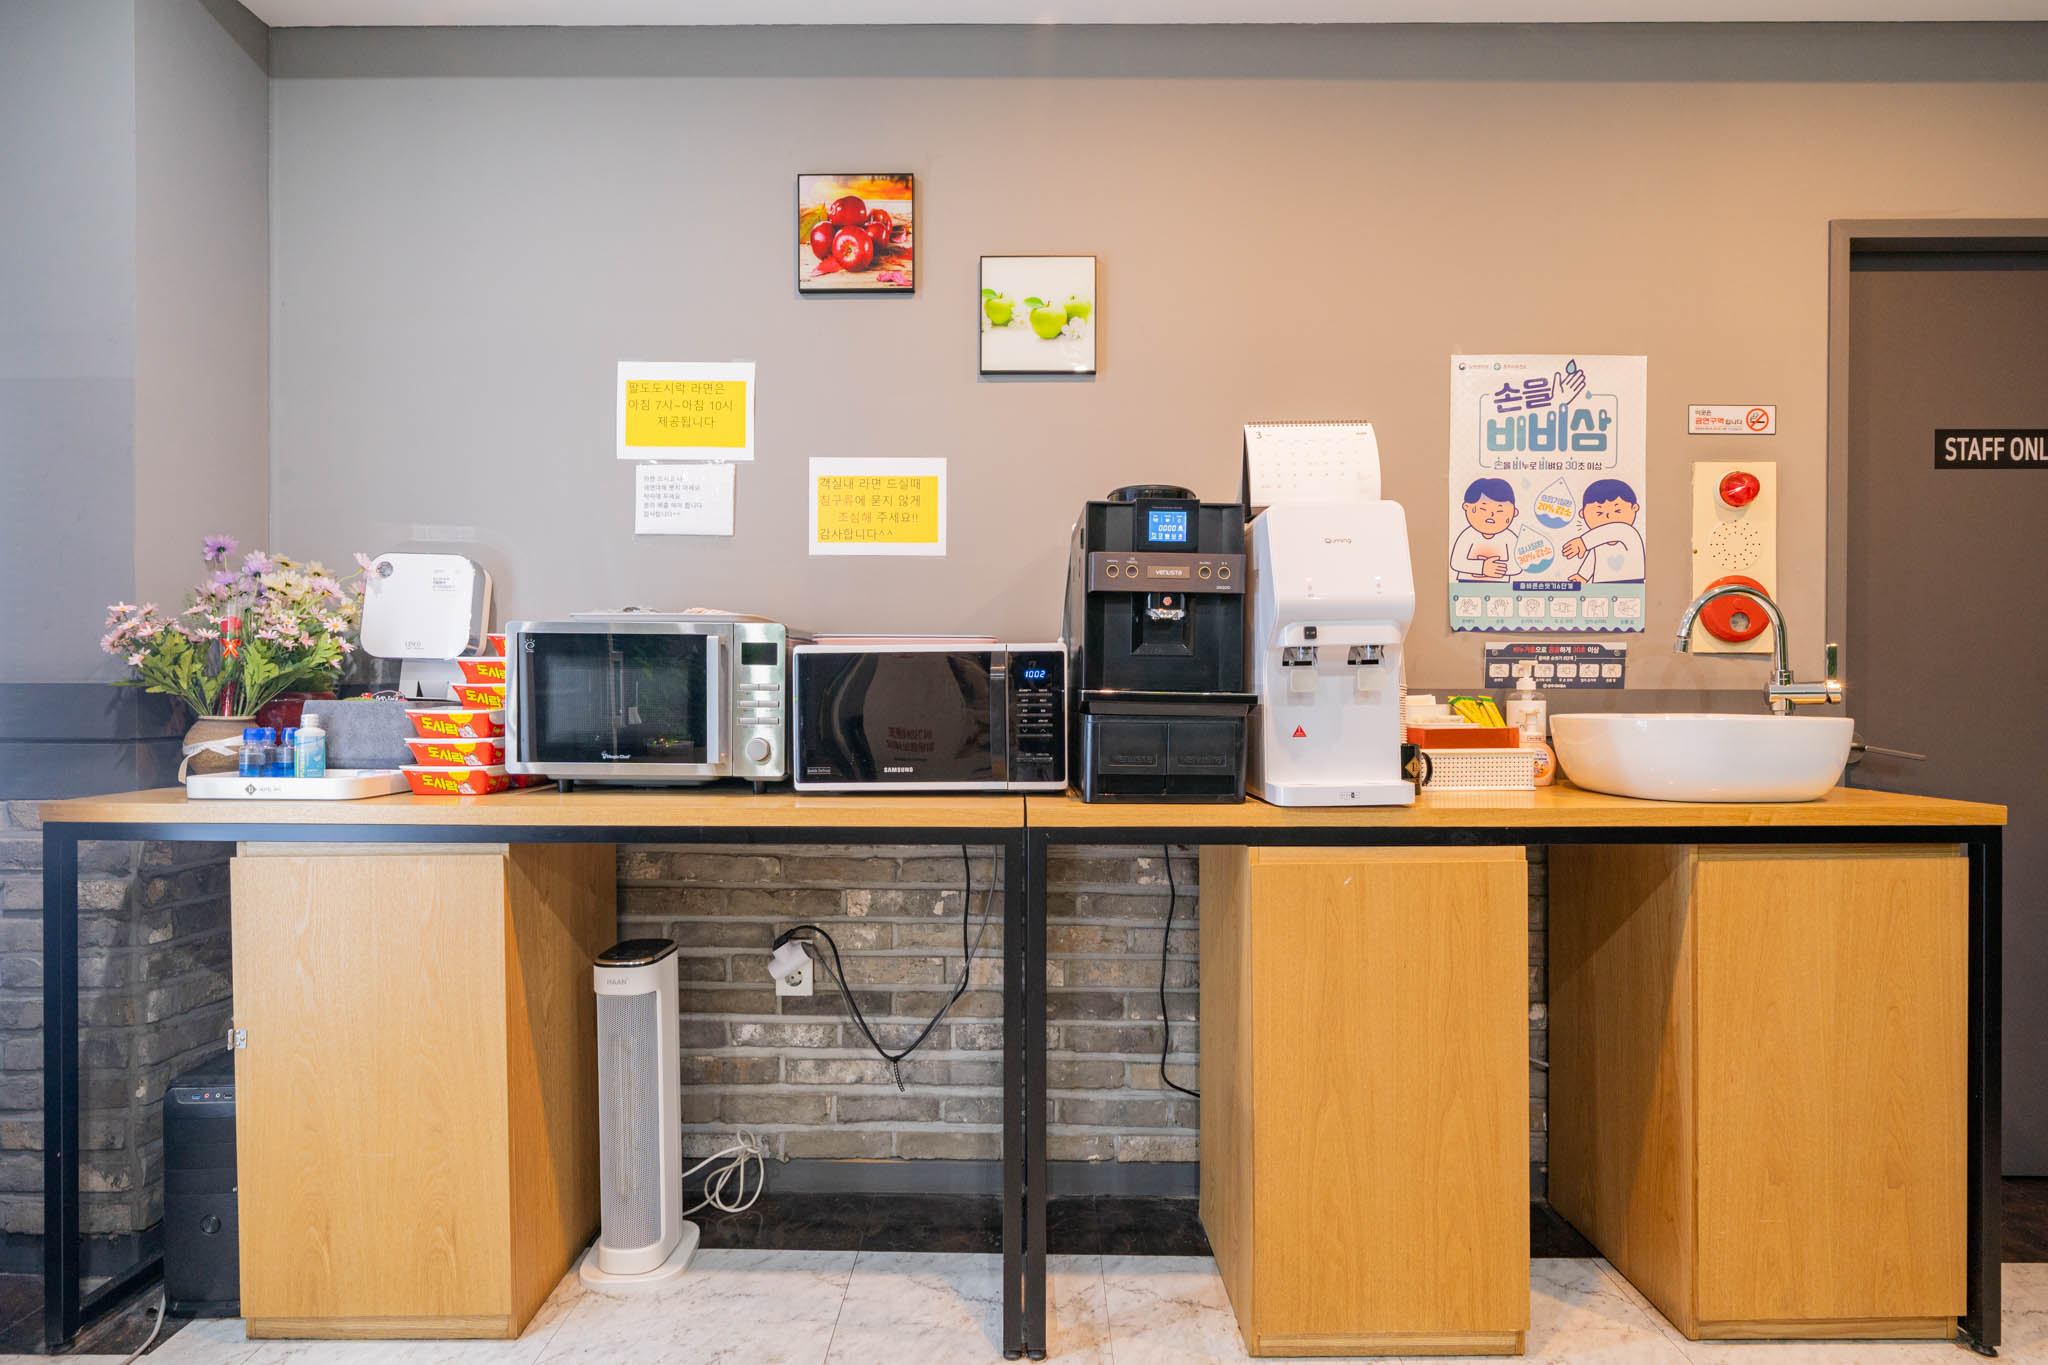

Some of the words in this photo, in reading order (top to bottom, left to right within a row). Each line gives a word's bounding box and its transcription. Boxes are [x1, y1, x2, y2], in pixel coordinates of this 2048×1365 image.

[691, 382, 726, 395] 라면은
[1493, 377, 1551, 413] 손을
[628, 399, 650, 411] 아침
[710, 399, 733, 412] 10시
[657, 415, 717, 429] 제공됩니다
[1486, 402, 1612, 452] 비비삼
[1944, 436, 2005, 461] STAFF
[2010, 436, 2048, 461] ONL
[1494, 460, 1511, 470] 손을
[1512, 460, 1537, 470] 비누로
[1538, 460, 1563, 470] 비벼요
[1565, 460, 1585, 470] 30초
[1587, 460, 1603, 470] 이상
[820, 477, 854, 490] 객실내
[859, 477, 881, 490] 라면
[887, 478, 921, 490] 드실때
[871, 494, 893, 507] 묻지
[898, 494, 921, 507] 않게
[1537, 502, 1554, 513] 20%
[1555, 505, 1572, 517] 감소
[838, 511, 872, 524] 조심해
[876, 511, 919, 523] 주세요!!
[820, 528, 894, 541] 감사합니다^^
[1535, 546, 1553, 558] 감소
[465, 689, 502, 709] 도시락
[421, 717, 459, 737] 도시락
[427, 746, 465, 765] 도시락
[421, 775, 459, 793] 도시락
